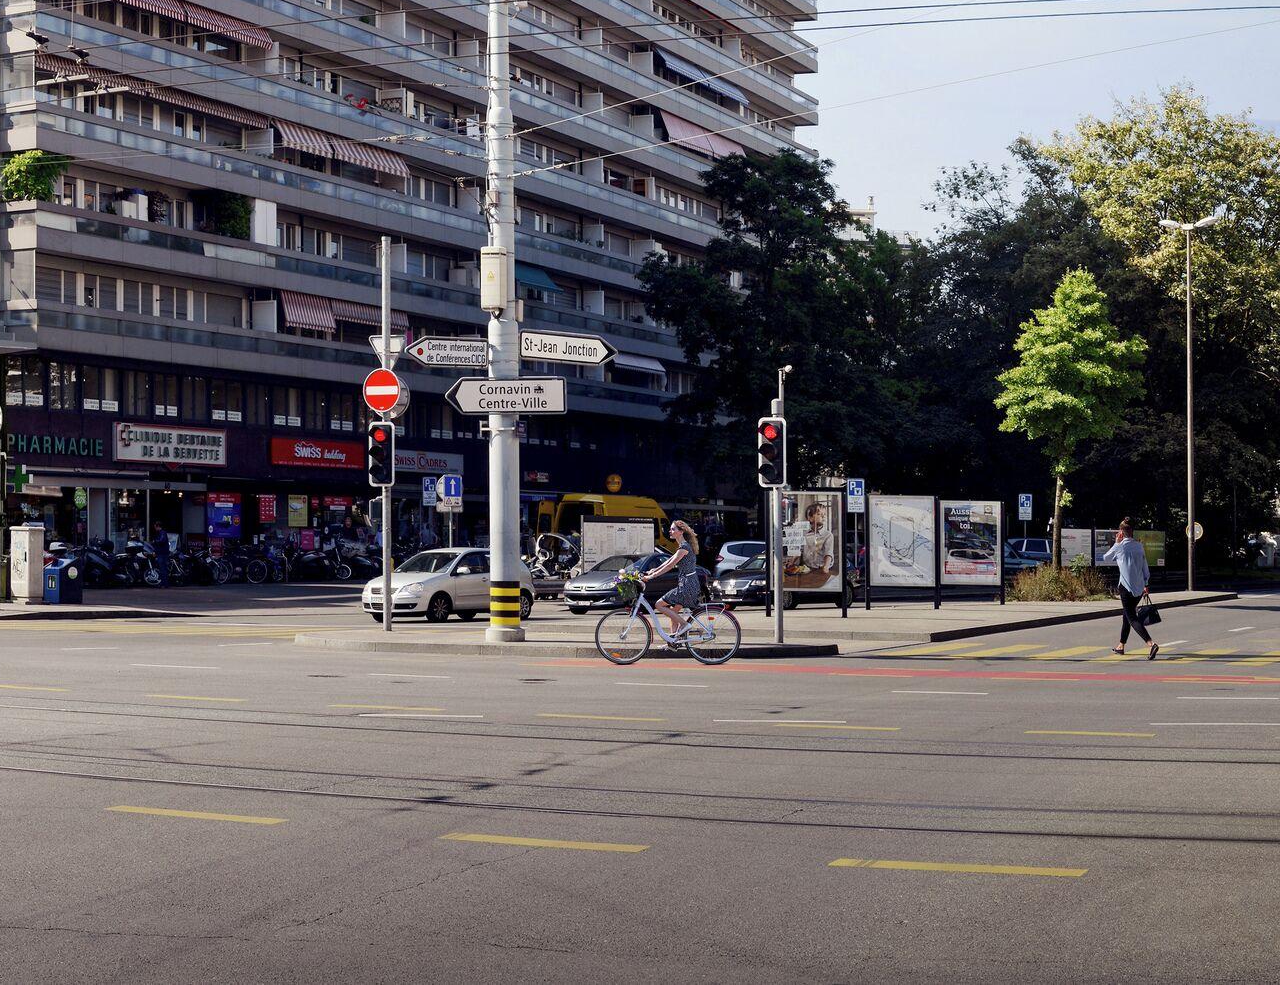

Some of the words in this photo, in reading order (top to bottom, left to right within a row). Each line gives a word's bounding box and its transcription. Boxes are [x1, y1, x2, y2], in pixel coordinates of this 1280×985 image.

[427, 341, 448, 352] Centre
[450, 342, 486, 353] international
[523, 337, 559, 354] St-Jean
[562, 341, 599, 358] Jonction
[426, 354, 435, 363] de
[471, 354, 486, 365] CICG
[479, 383, 531, 395] Cornavin
[478, 398, 548, 410] Centre-Ville
[6, 433, 104, 457] PHARMACIE
[127, 428, 173, 446] CLINIQUE
[176, 432, 223, 448] DENTAIRE
[141, 445, 155, 457] DE
[157, 446, 170, 458] LA
[173, 447, 220, 461] SERVETTE
[294, 445, 322, 459] SWISS
